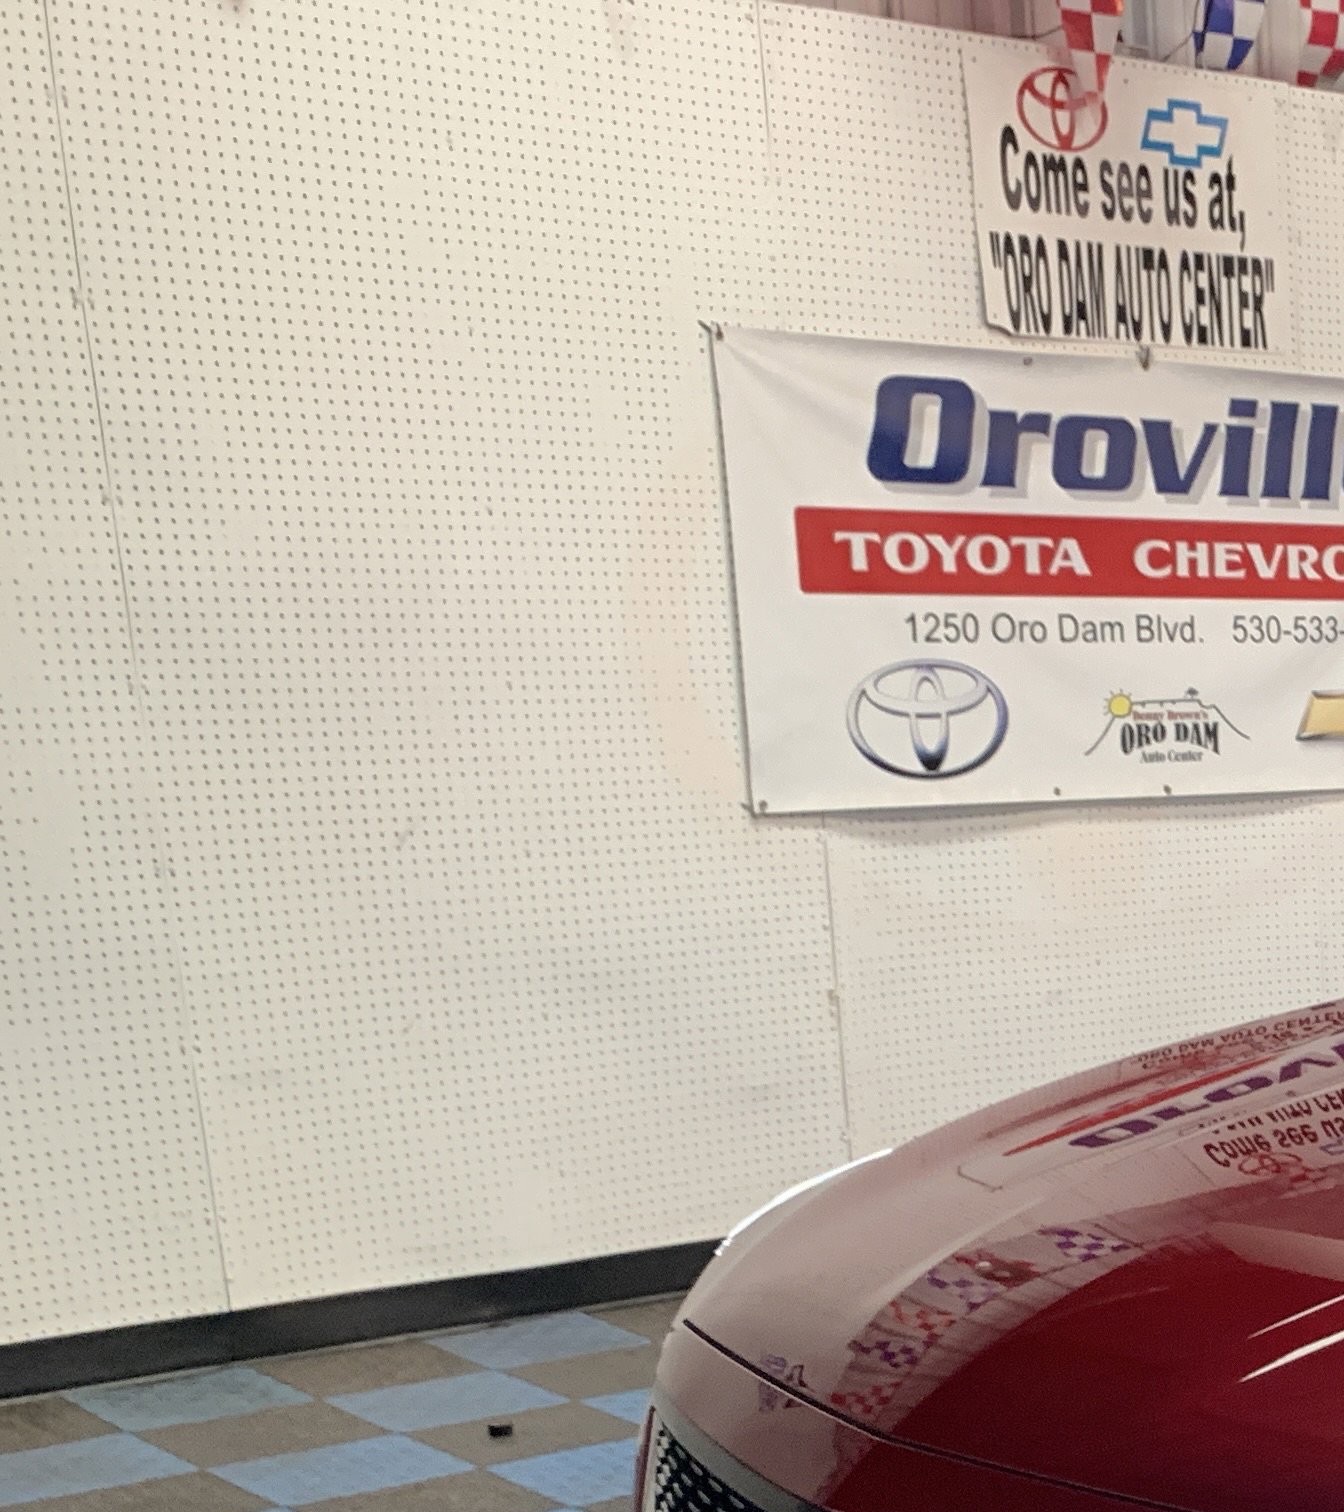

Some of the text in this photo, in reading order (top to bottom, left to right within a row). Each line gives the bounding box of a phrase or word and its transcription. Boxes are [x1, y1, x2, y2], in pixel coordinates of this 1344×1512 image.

[1000, 124, 1246, 252] Come see us at,
[989, 230, 1275, 350] "ORO DAM AUTO CENTER"
[833, 530, 1092, 578] TOYOTA
[904, 612, 980, 645] 1250
[990, 613, 1049, 645] Oro
[1058, 614, 1126, 645] Dam
[1136, 614, 1206, 645] Blvd.
[1120, 720, 1221, 756] ORO DAM
[1140, 750, 1204, 764] Auto Center
